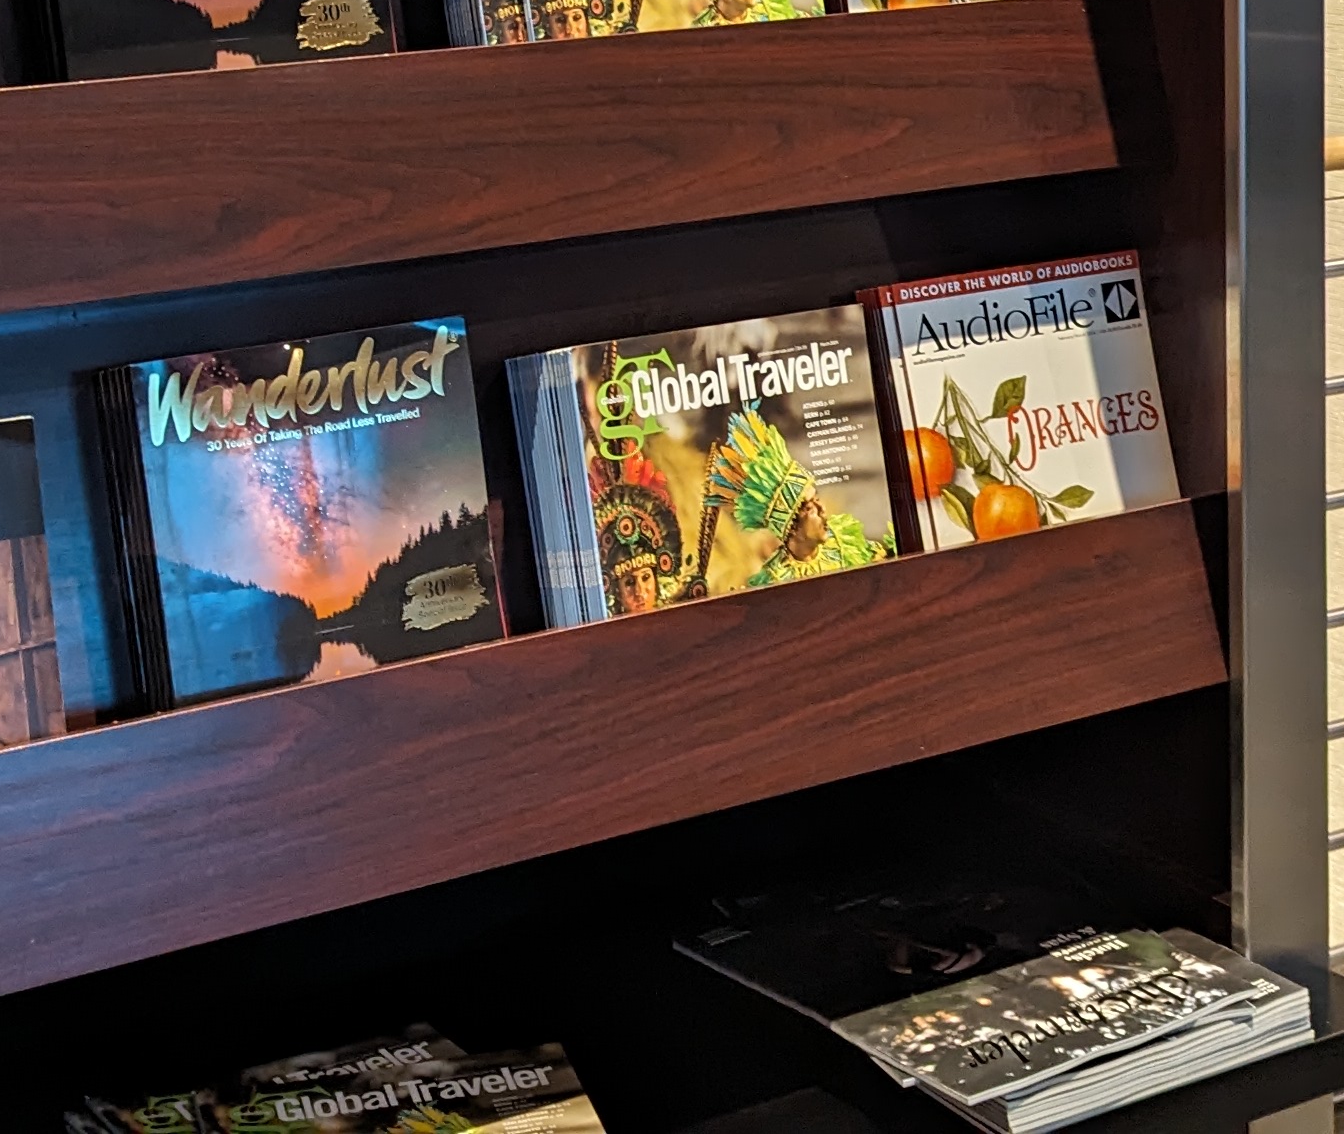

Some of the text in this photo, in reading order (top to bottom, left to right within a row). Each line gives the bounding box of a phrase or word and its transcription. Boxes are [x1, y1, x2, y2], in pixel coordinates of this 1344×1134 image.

[899, 255, 1133, 300] DISCOVER THE WORLD OF AUDIOBOOKS
[911, 287, 1095, 356] AudioFile
[147, 324, 460, 447] Wanderlust
[631, 342, 853, 419] Global Traveler
[206, 440, 223, 452] 30
[254, 431, 268, 444] Of
[269, 427, 304, 442] Taking
[304, 424, 324, 436] The
[325, 420, 351, 433] Road
[352, 415, 375, 428] Less
[376, 406, 421, 424] Travelled
[1006, 390, 1159, 472] ORANGES
[273, 1083, 398, 1122] Global
[401, 1064, 554, 1104] Traveler
